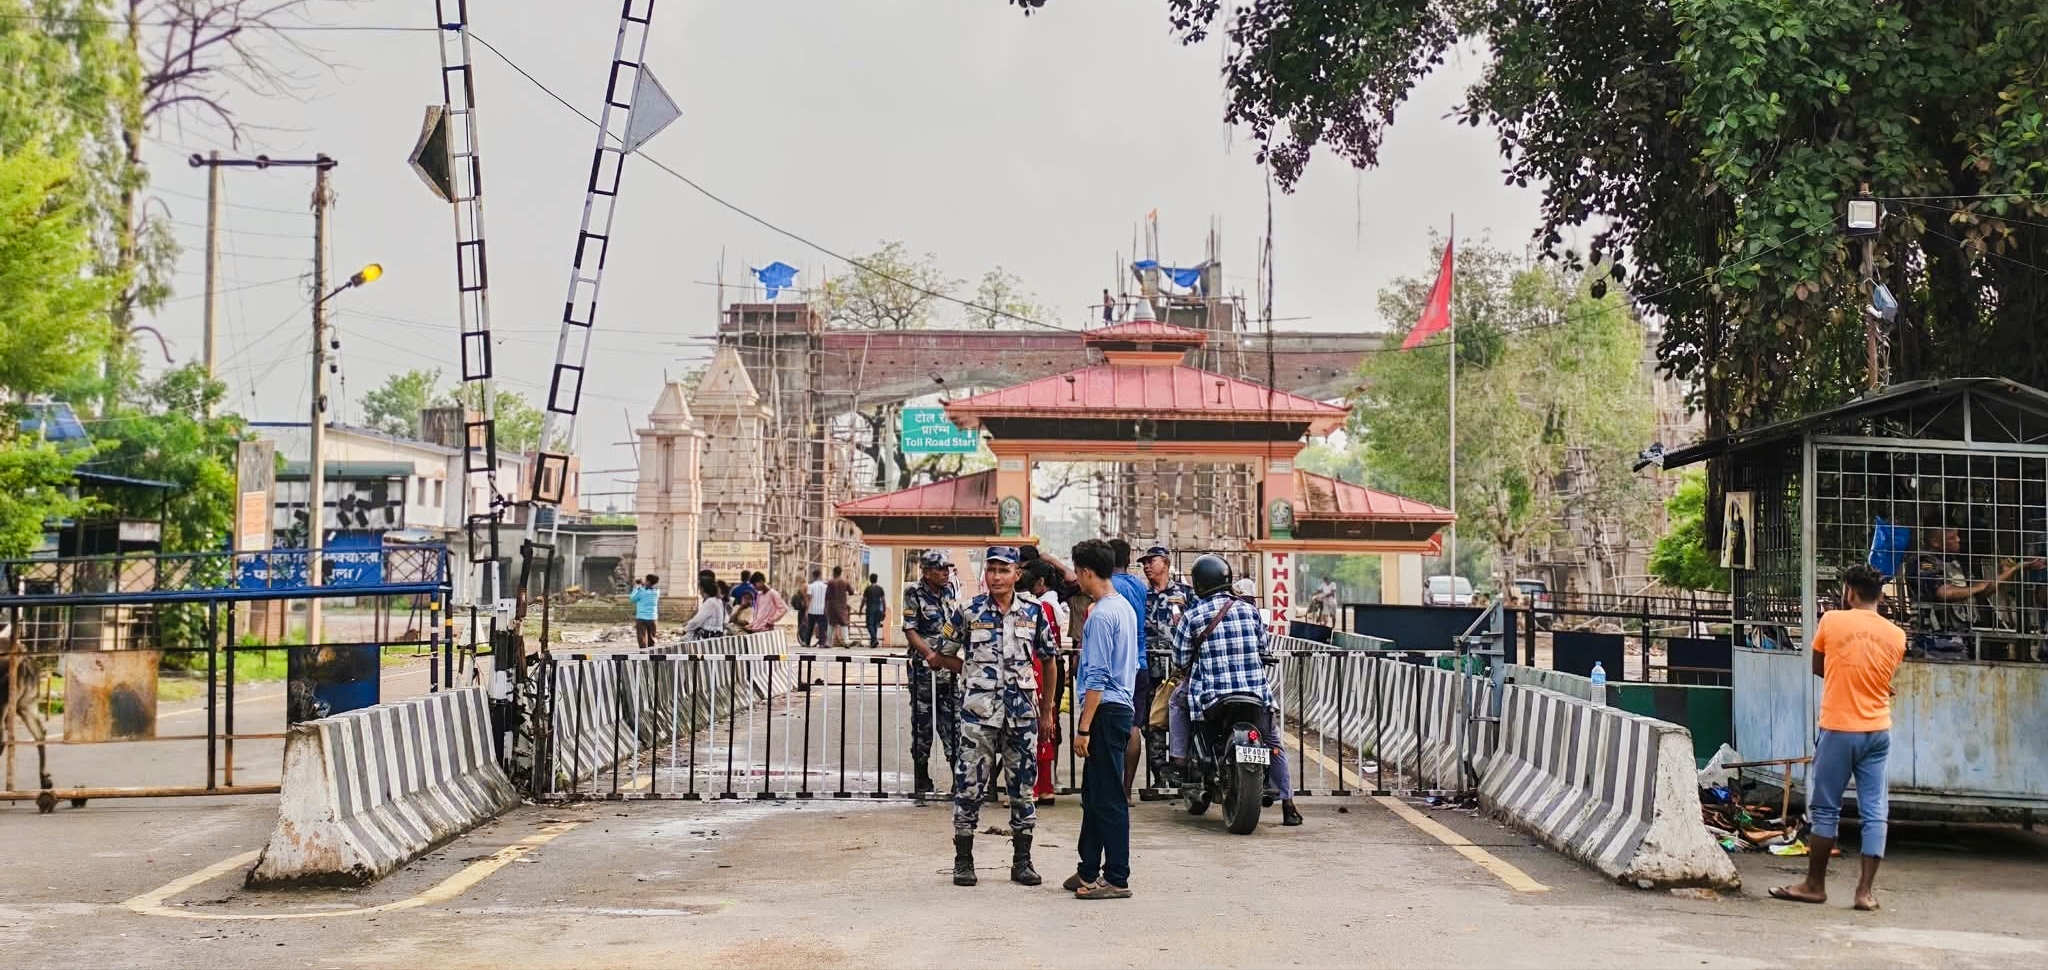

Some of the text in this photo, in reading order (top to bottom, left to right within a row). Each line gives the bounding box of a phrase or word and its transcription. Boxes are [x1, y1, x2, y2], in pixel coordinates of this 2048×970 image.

[915, 410, 935, 423] टोल
[904, 437, 976, 447] Toll Road Start
[1271, 552, 1289, 622] THANK
